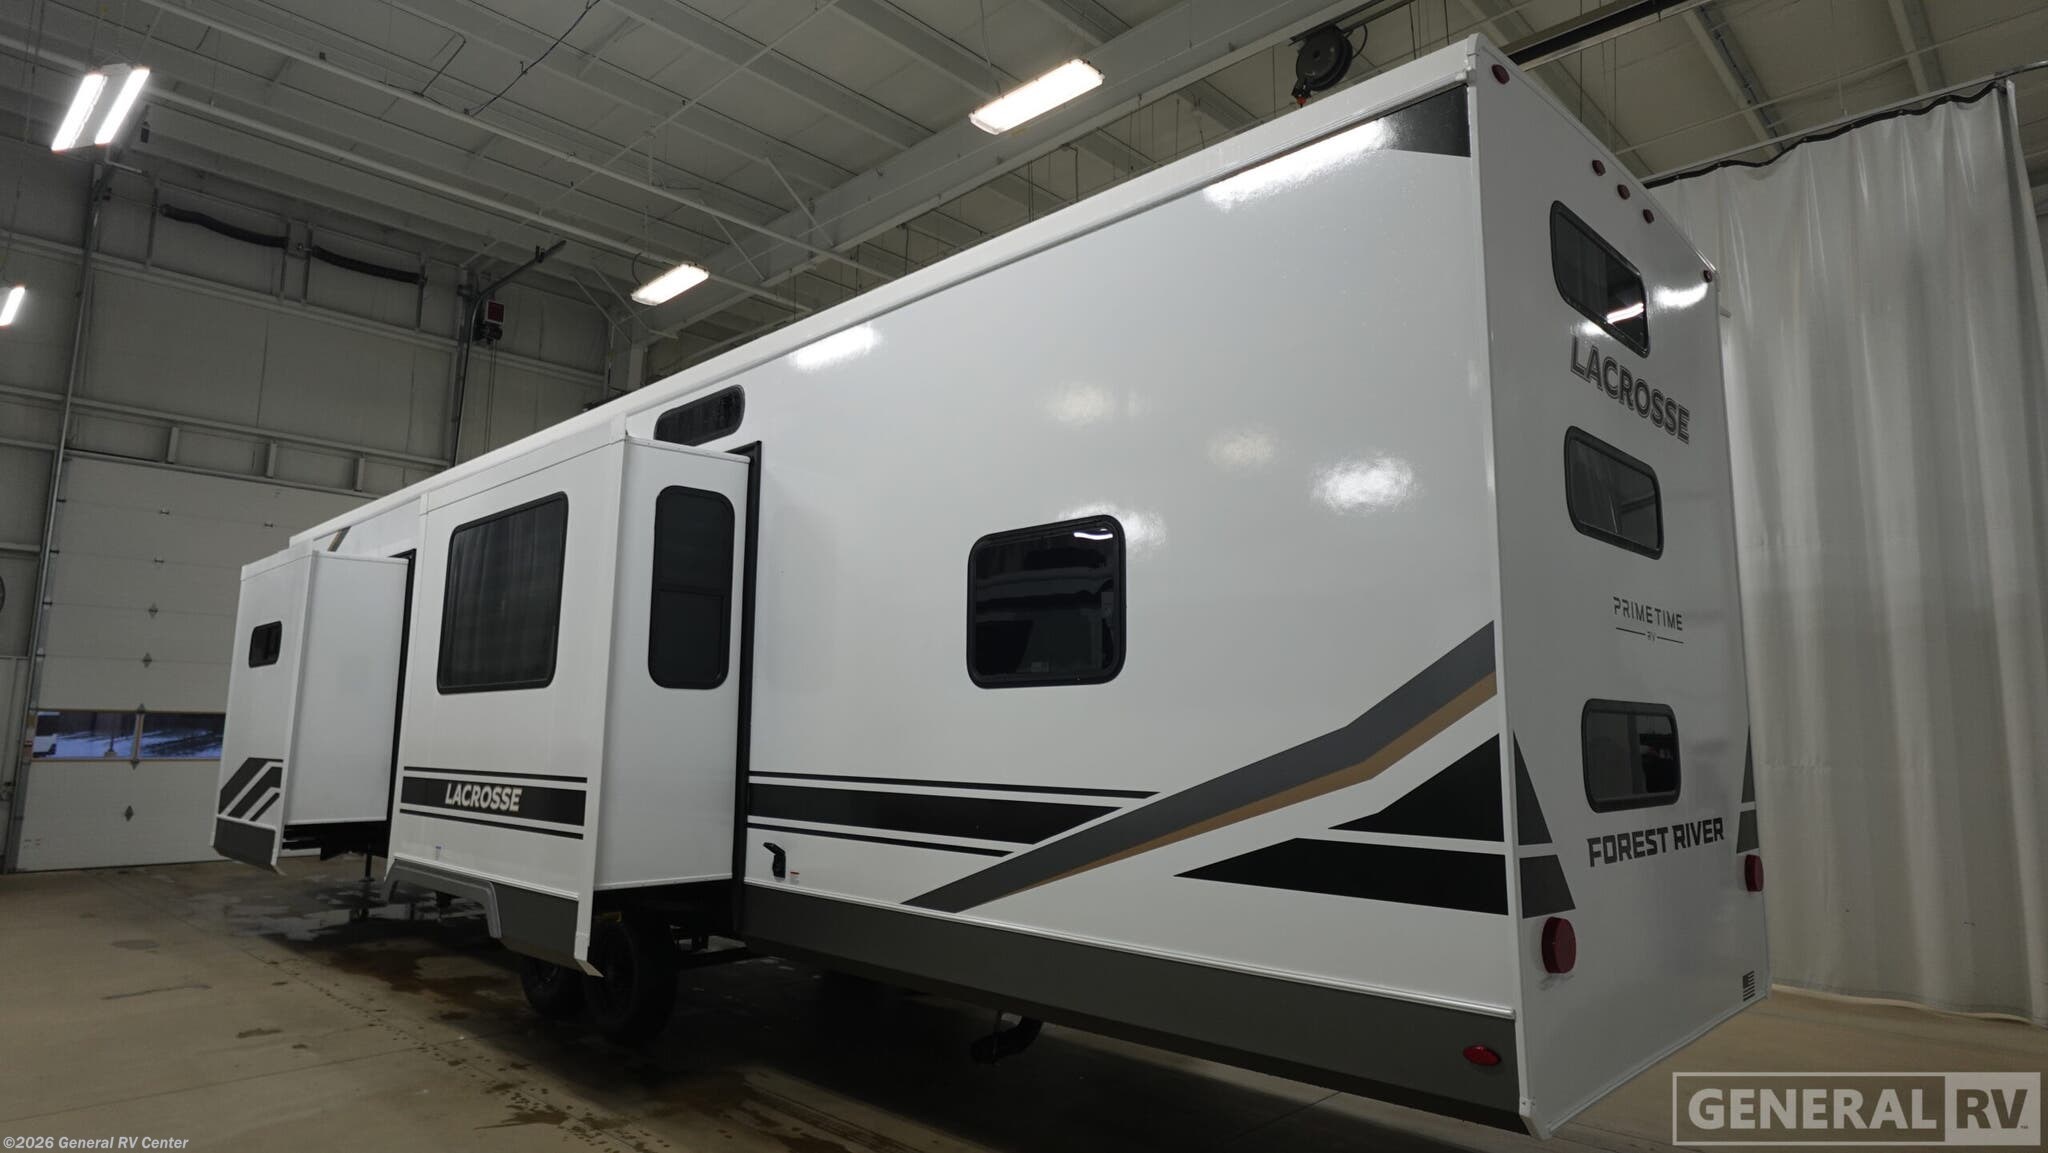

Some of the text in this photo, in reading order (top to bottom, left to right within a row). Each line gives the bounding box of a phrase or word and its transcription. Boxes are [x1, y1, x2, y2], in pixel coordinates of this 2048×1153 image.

[1571, 335, 1690, 445] LACROSSE
[445, 783, 523, 811] LACROSSE
[1587, 817, 1724, 868] FOREST RIVER
